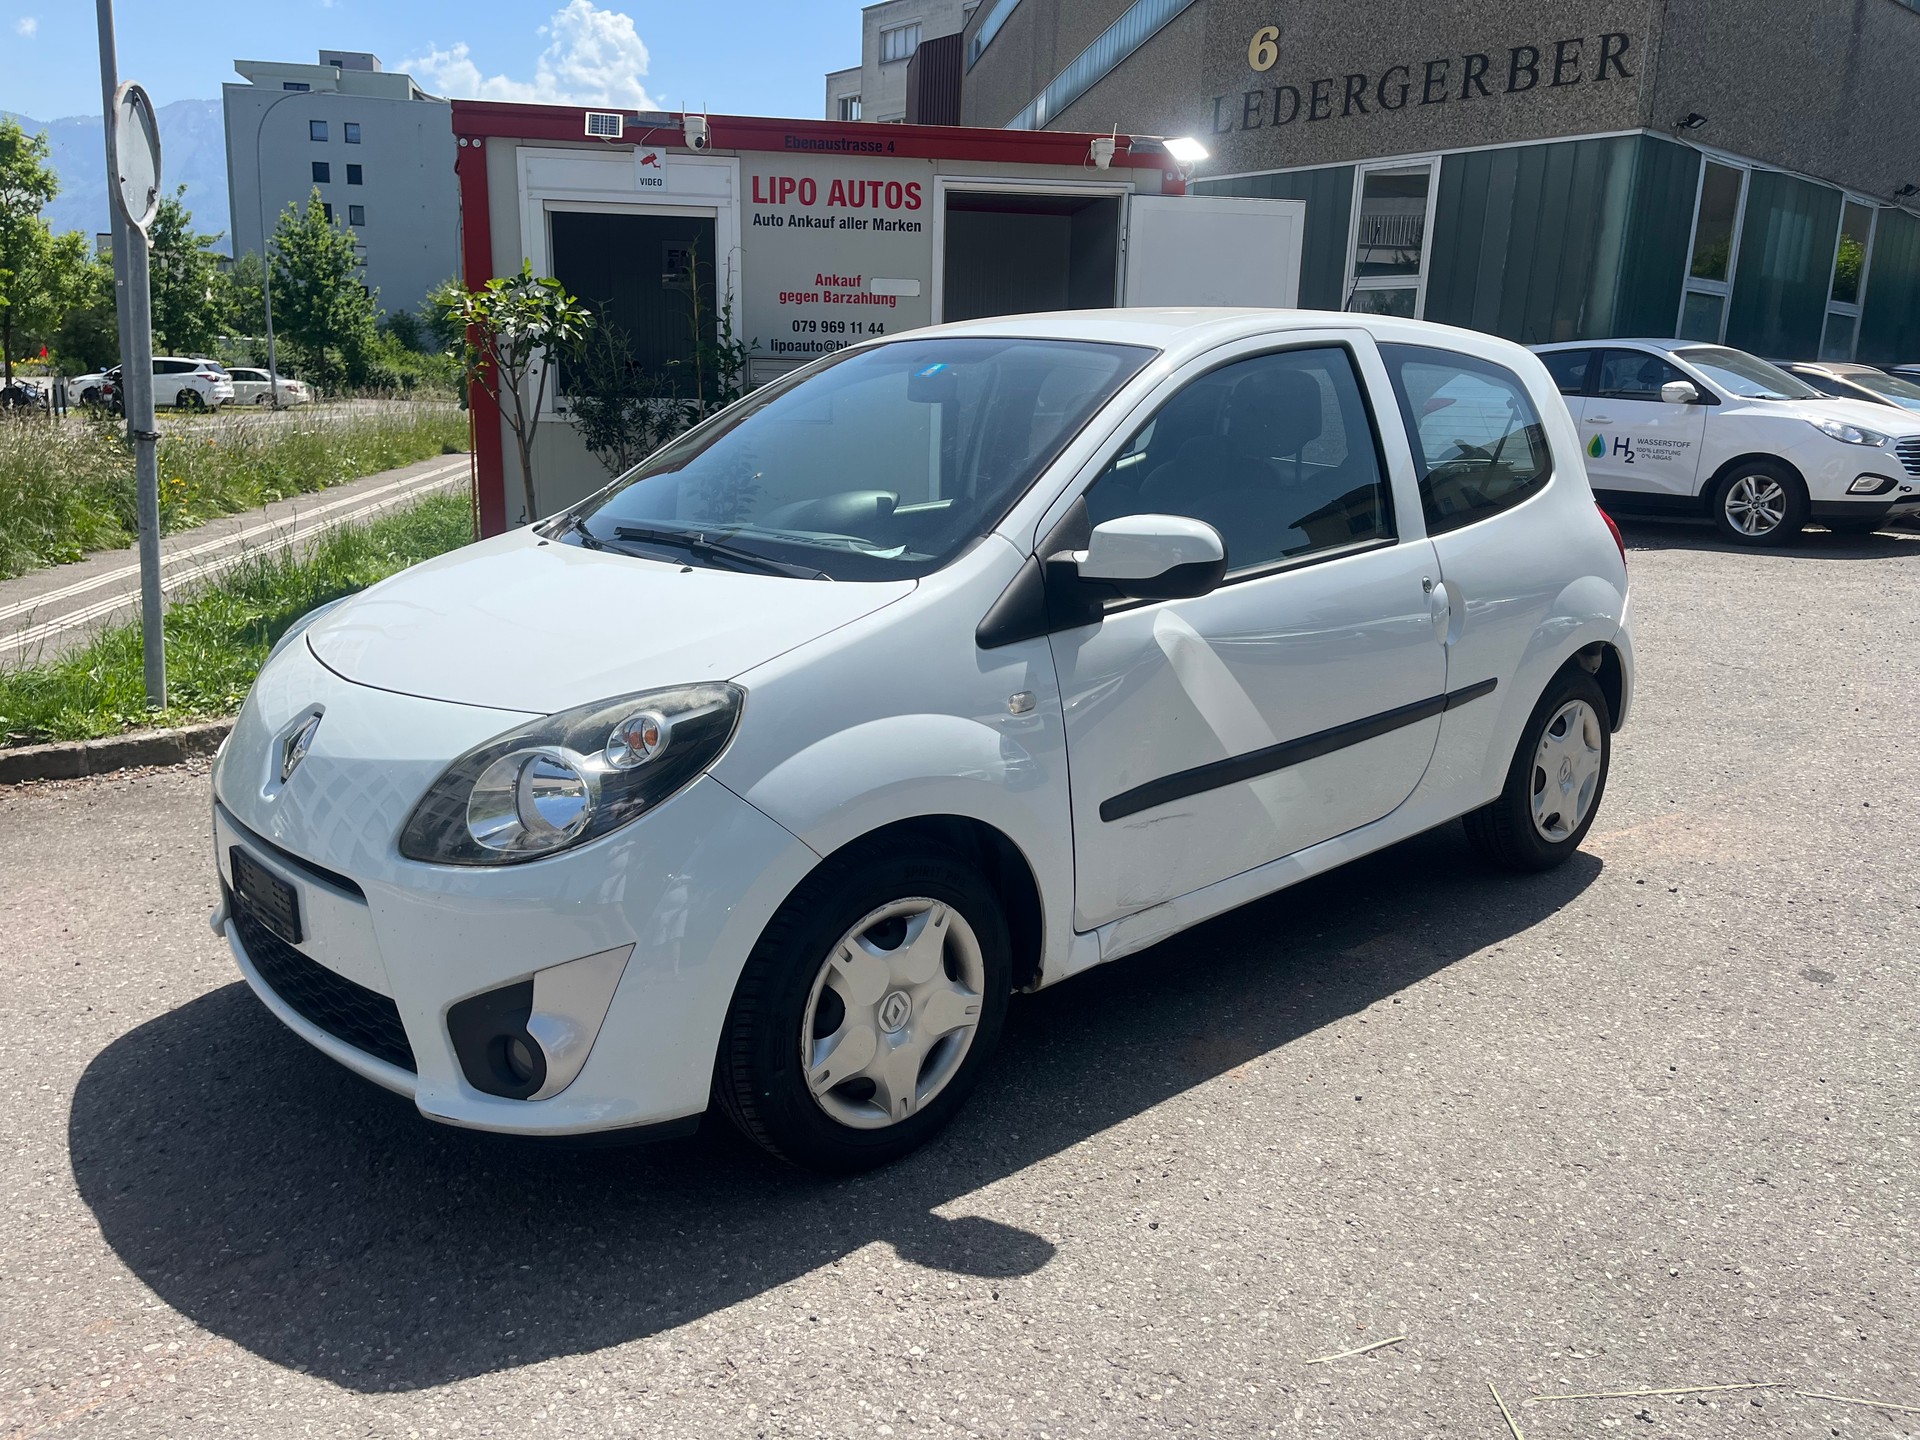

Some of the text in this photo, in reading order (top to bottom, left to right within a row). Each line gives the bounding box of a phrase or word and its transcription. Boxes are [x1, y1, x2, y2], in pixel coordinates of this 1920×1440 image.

[1247, 25, 1281, 72] 6
[1209, 31, 1635, 136] LEDERGERBER
[784, 135, 895, 153] Ebenaustrasse 4
[639, 177, 663, 187] VIDEO
[752, 175, 922, 211] LIPO AUTOS
[753, 213, 922, 233] Auto Ankauf aller Marken
[815, 273, 862, 288] Ankauf
[779, 290, 897, 308] gegen Barzahlung
[792, 320, 884, 335] 079 969 11 44
[770, 338, 855, 354] lipoauto@bl
[1637, 438, 1691, 448] WASSERSTOFF
